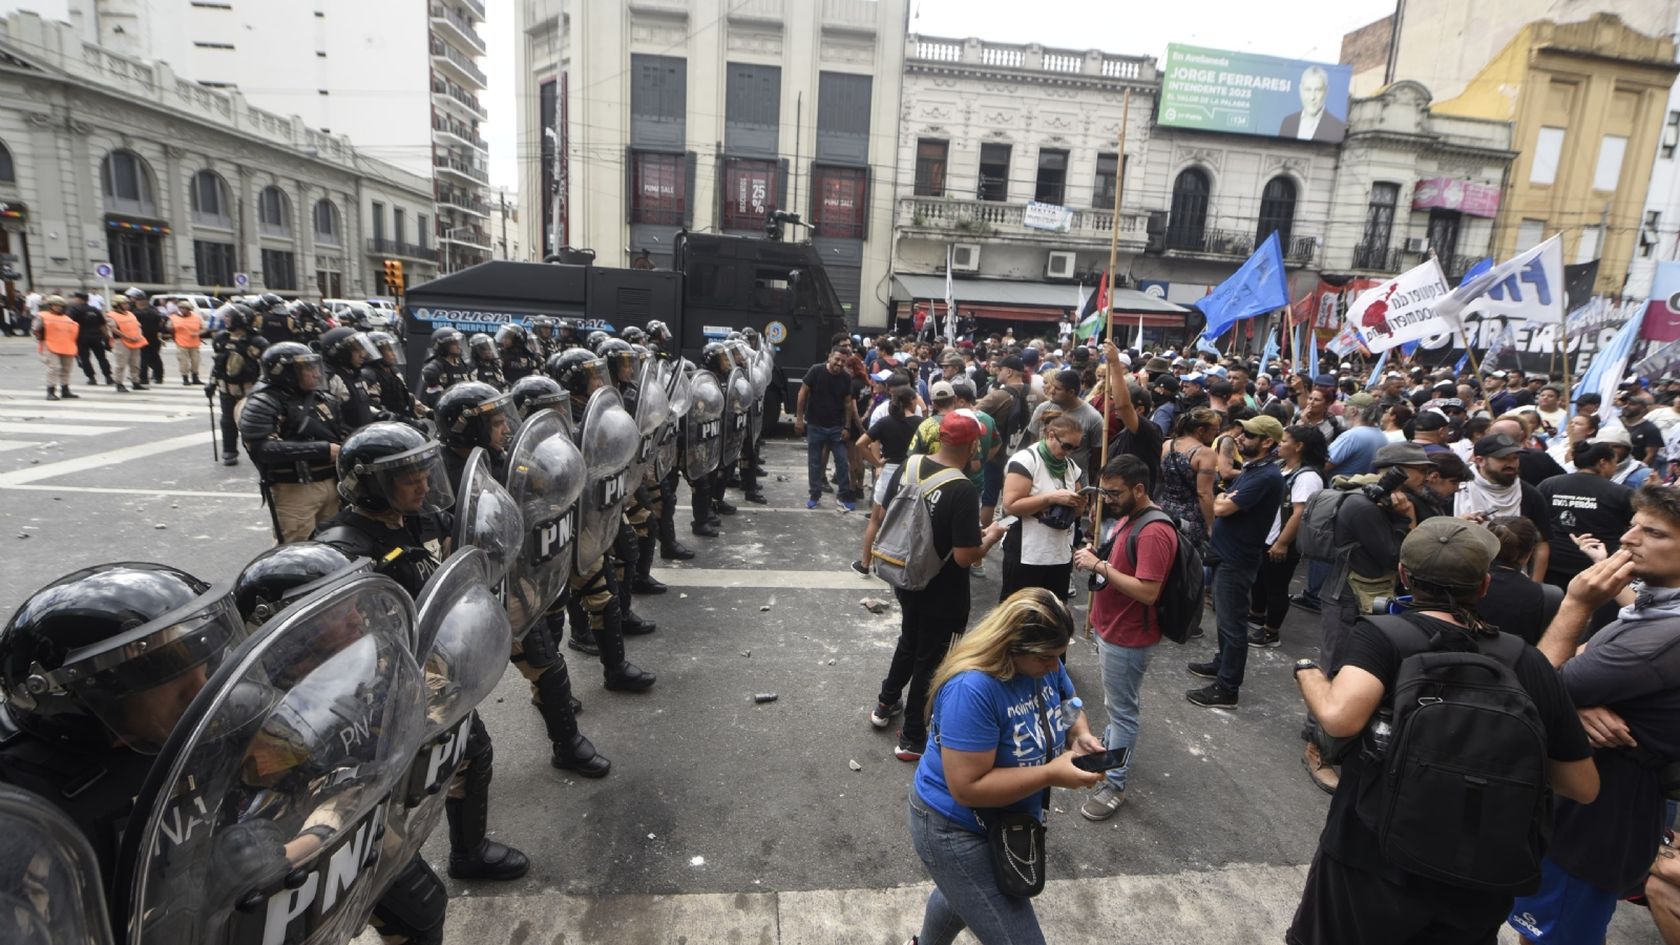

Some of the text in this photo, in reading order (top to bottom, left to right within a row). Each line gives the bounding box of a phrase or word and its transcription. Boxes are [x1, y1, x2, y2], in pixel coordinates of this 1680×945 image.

[1173, 52, 1184, 60] En
[1170, 67, 1291, 92] JORGE FERRARESI
[1168, 80, 1228, 95] INTENDENTE
[1176, 94, 1199, 103] VALOR
[1210, 98, 1219, 106] LA
[1220, 99, 1250, 108] PALABRA
[752, 184, 766, 199] 25
[752, 199, 765, 213] %
[432, 309, 512, 325] POLICIA
